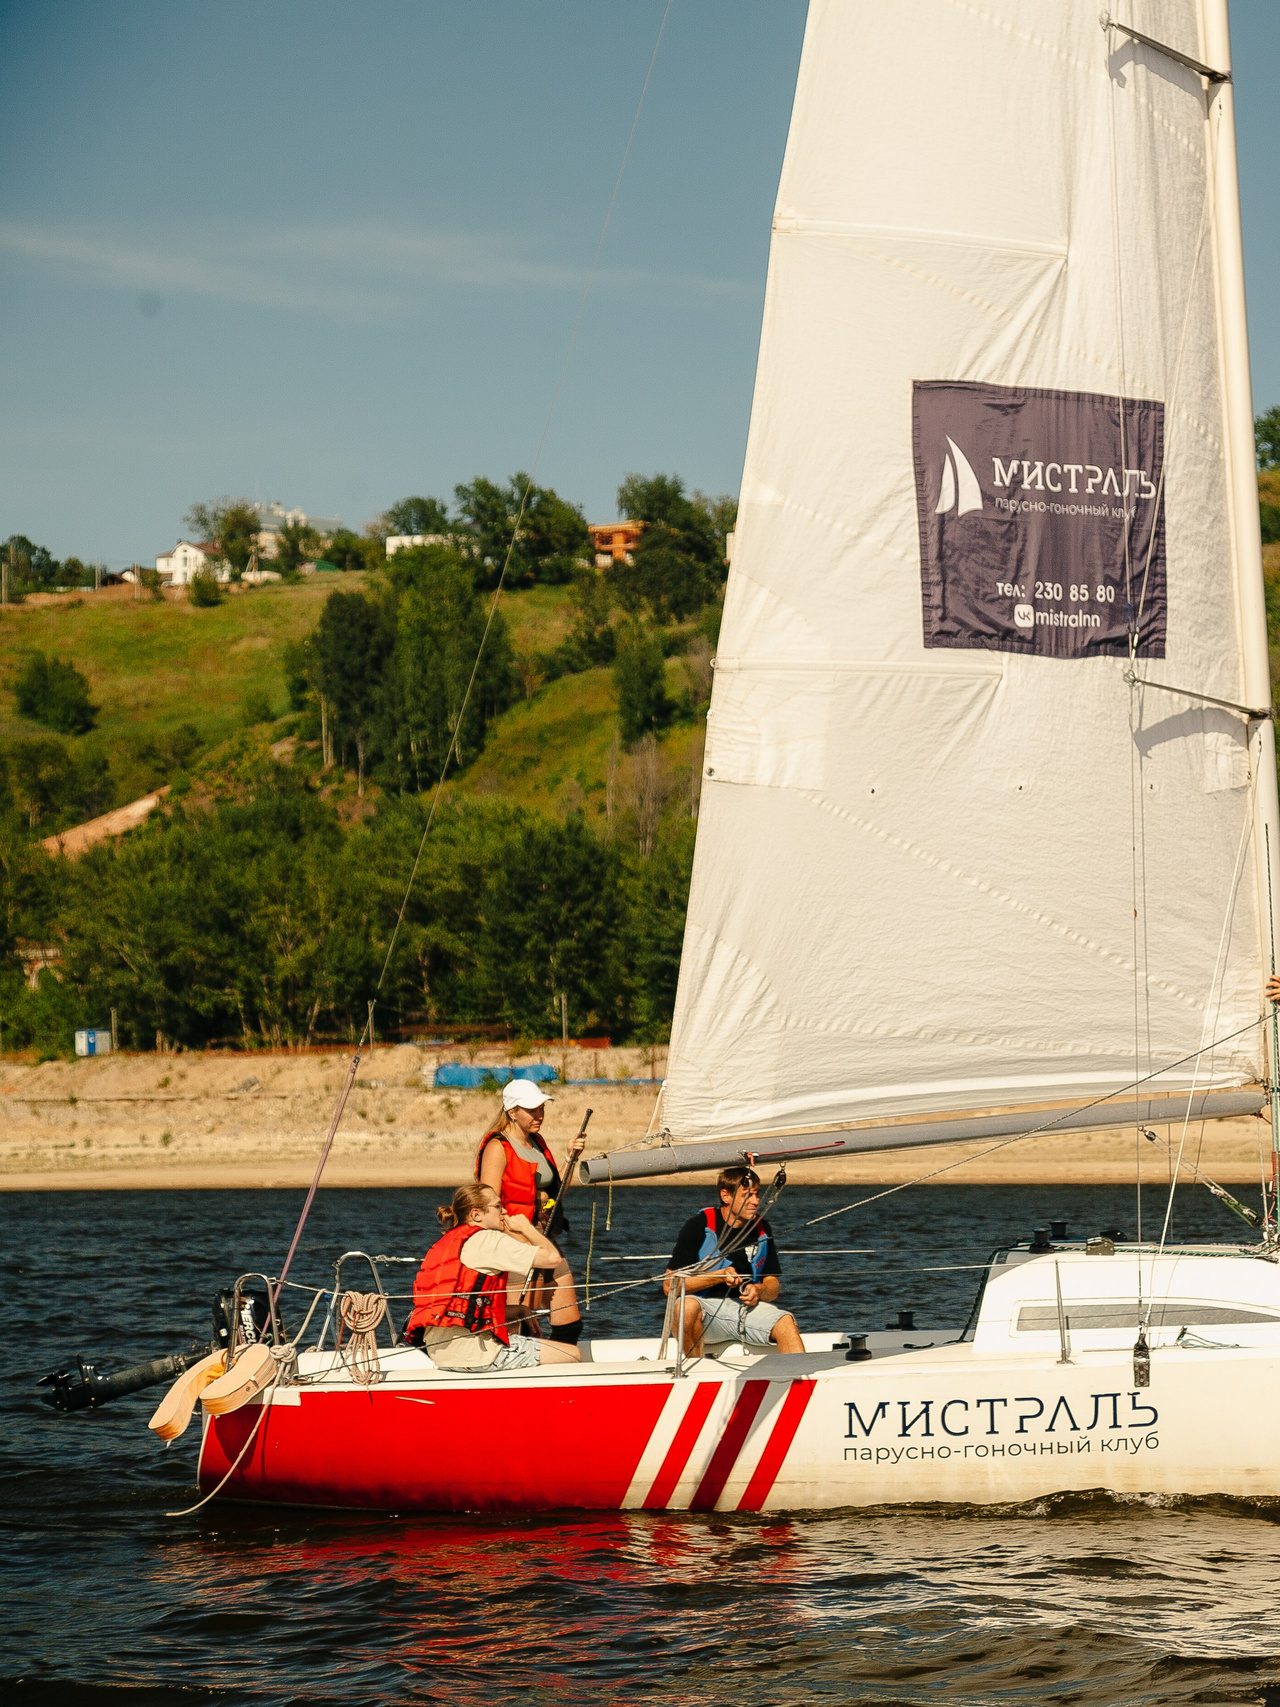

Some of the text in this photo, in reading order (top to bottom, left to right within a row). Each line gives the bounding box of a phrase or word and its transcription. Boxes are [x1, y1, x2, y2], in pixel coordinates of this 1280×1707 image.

[995, 498, 1109, 517] парусно-гоночный
[996, 581, 1115, 603] тел: 230 85 80
[1035, 608, 1101, 628] mistralnn
[843, 1391, 1159, 1438] МИСТРАЛЬ
[843, 1431, 1160, 1465] парусно-гоночный клуб
